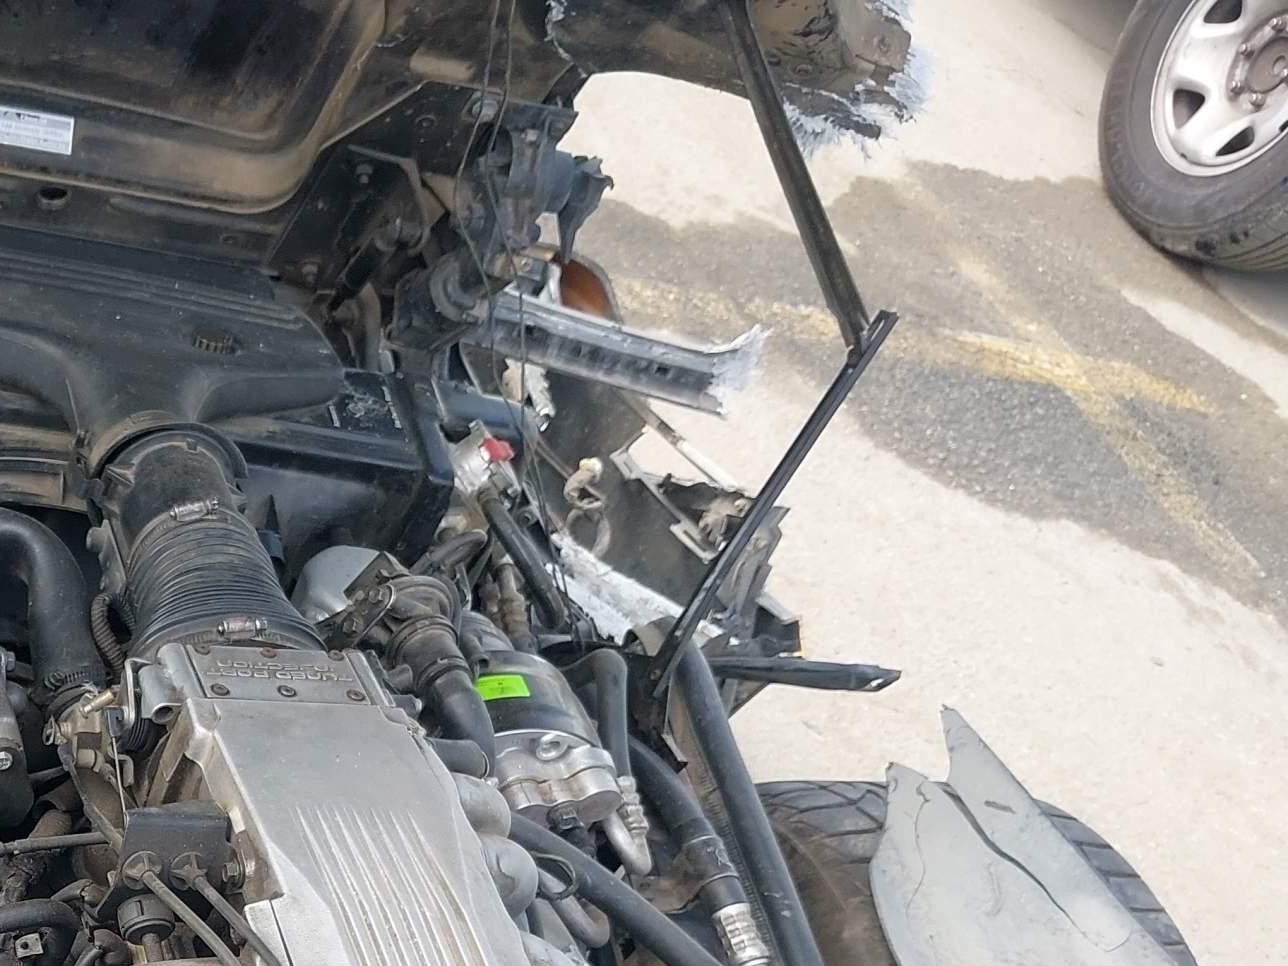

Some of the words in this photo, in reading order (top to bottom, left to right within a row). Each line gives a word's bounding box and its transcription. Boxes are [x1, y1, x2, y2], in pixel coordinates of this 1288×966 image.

[216, 659, 334, 672] INJECTION
[206, 667, 272, 679] PORT
[276, 670, 352, 682] TUNED
